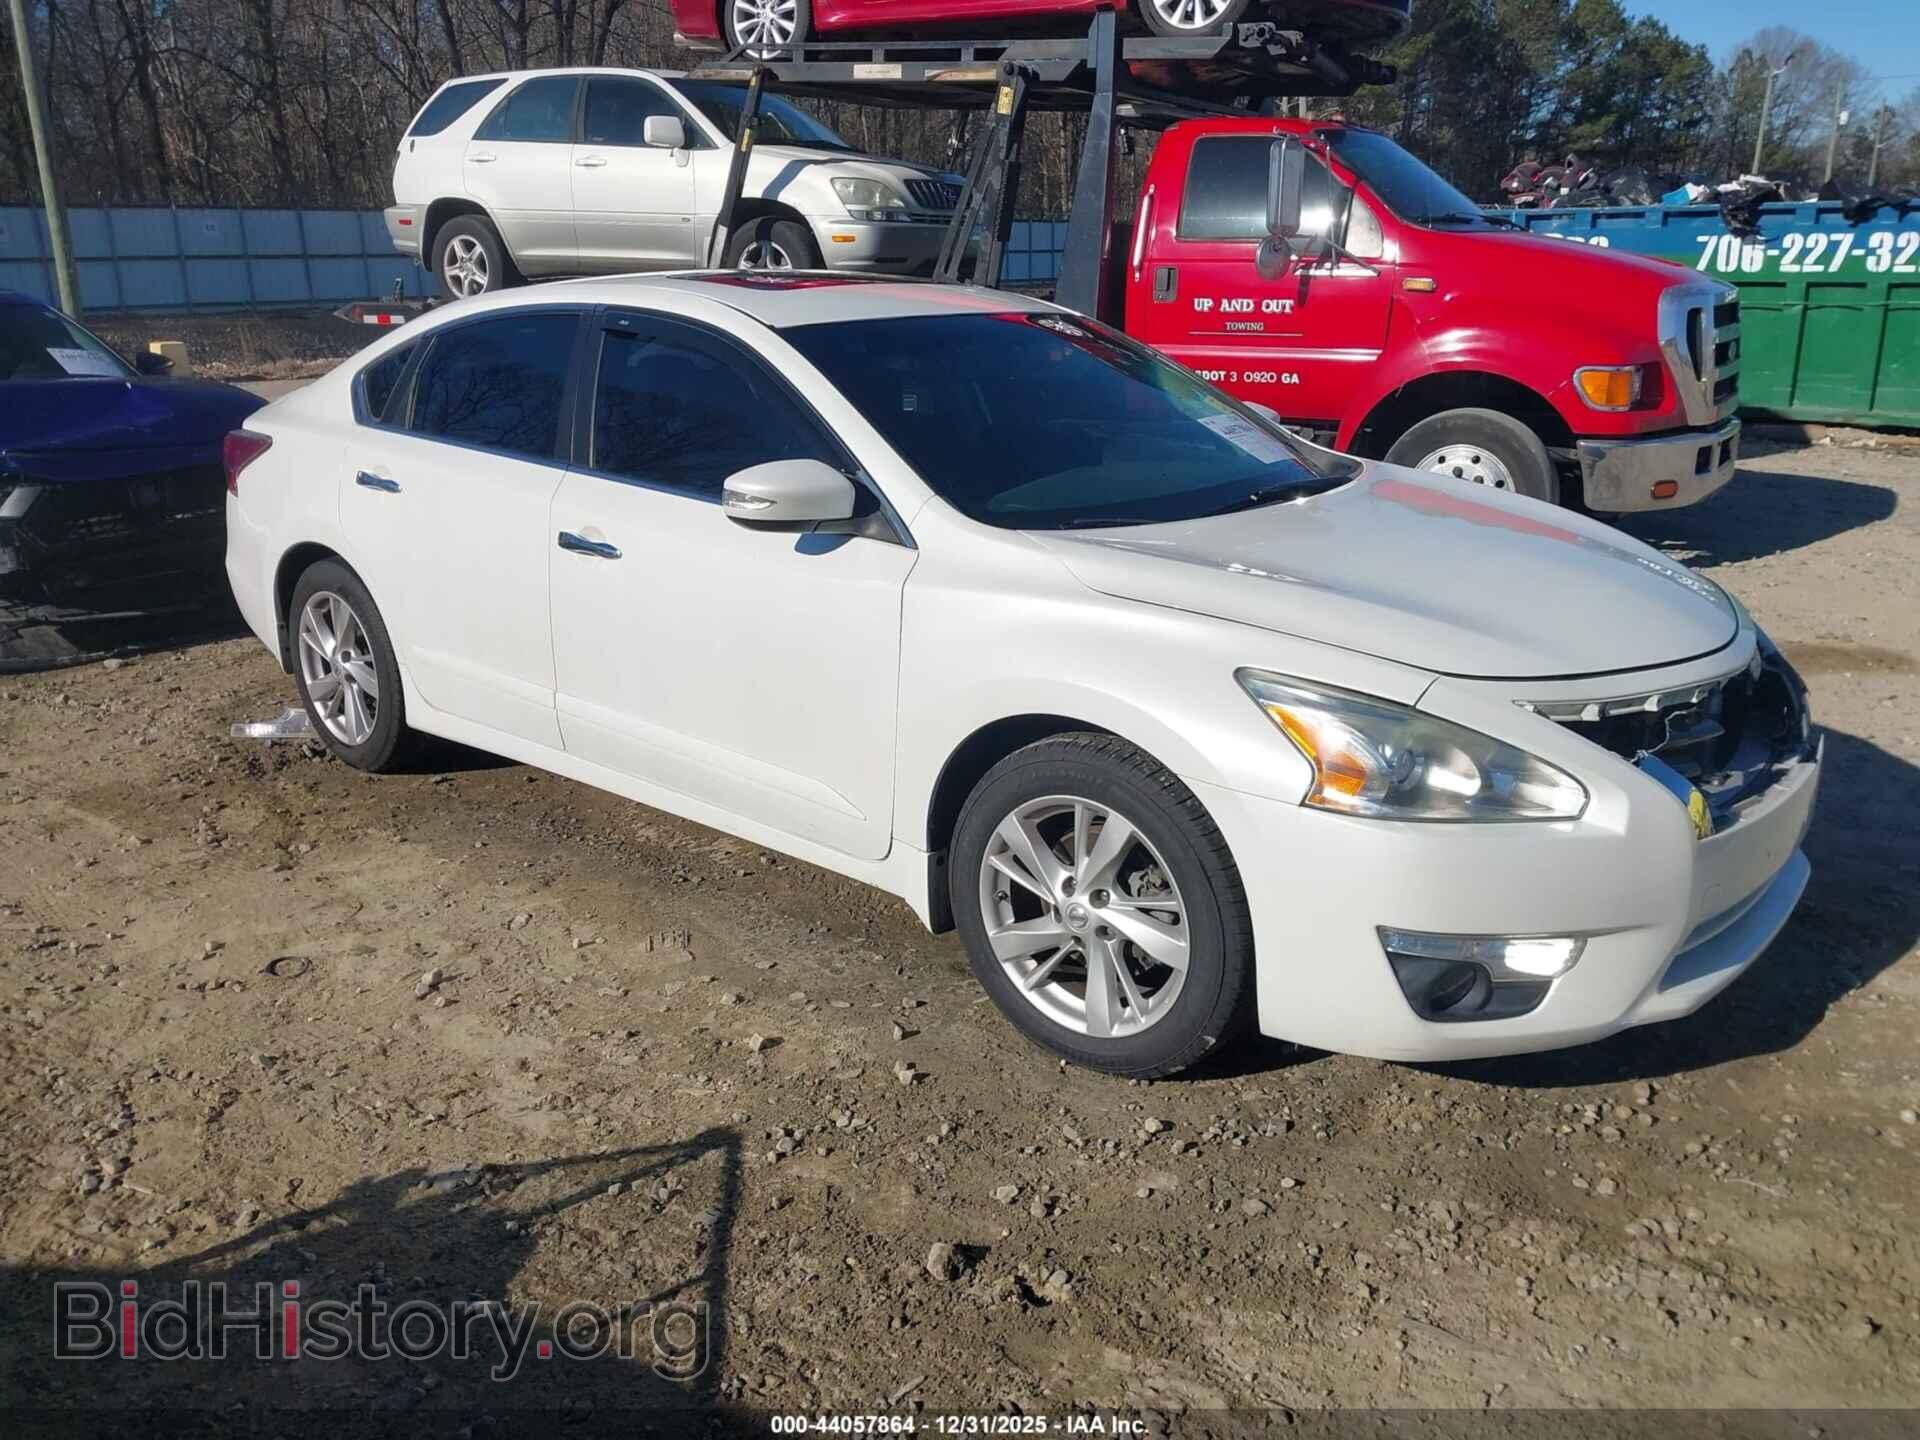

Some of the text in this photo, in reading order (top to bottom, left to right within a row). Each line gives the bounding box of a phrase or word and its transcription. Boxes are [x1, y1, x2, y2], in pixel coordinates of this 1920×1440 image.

[1696, 231, 1920, 273] 706-227-32
[1193, 297, 1295, 313] UP AND OUT
[1225, 321, 1264, 331] TOWING
[1281, 373, 1300, 384] GA
